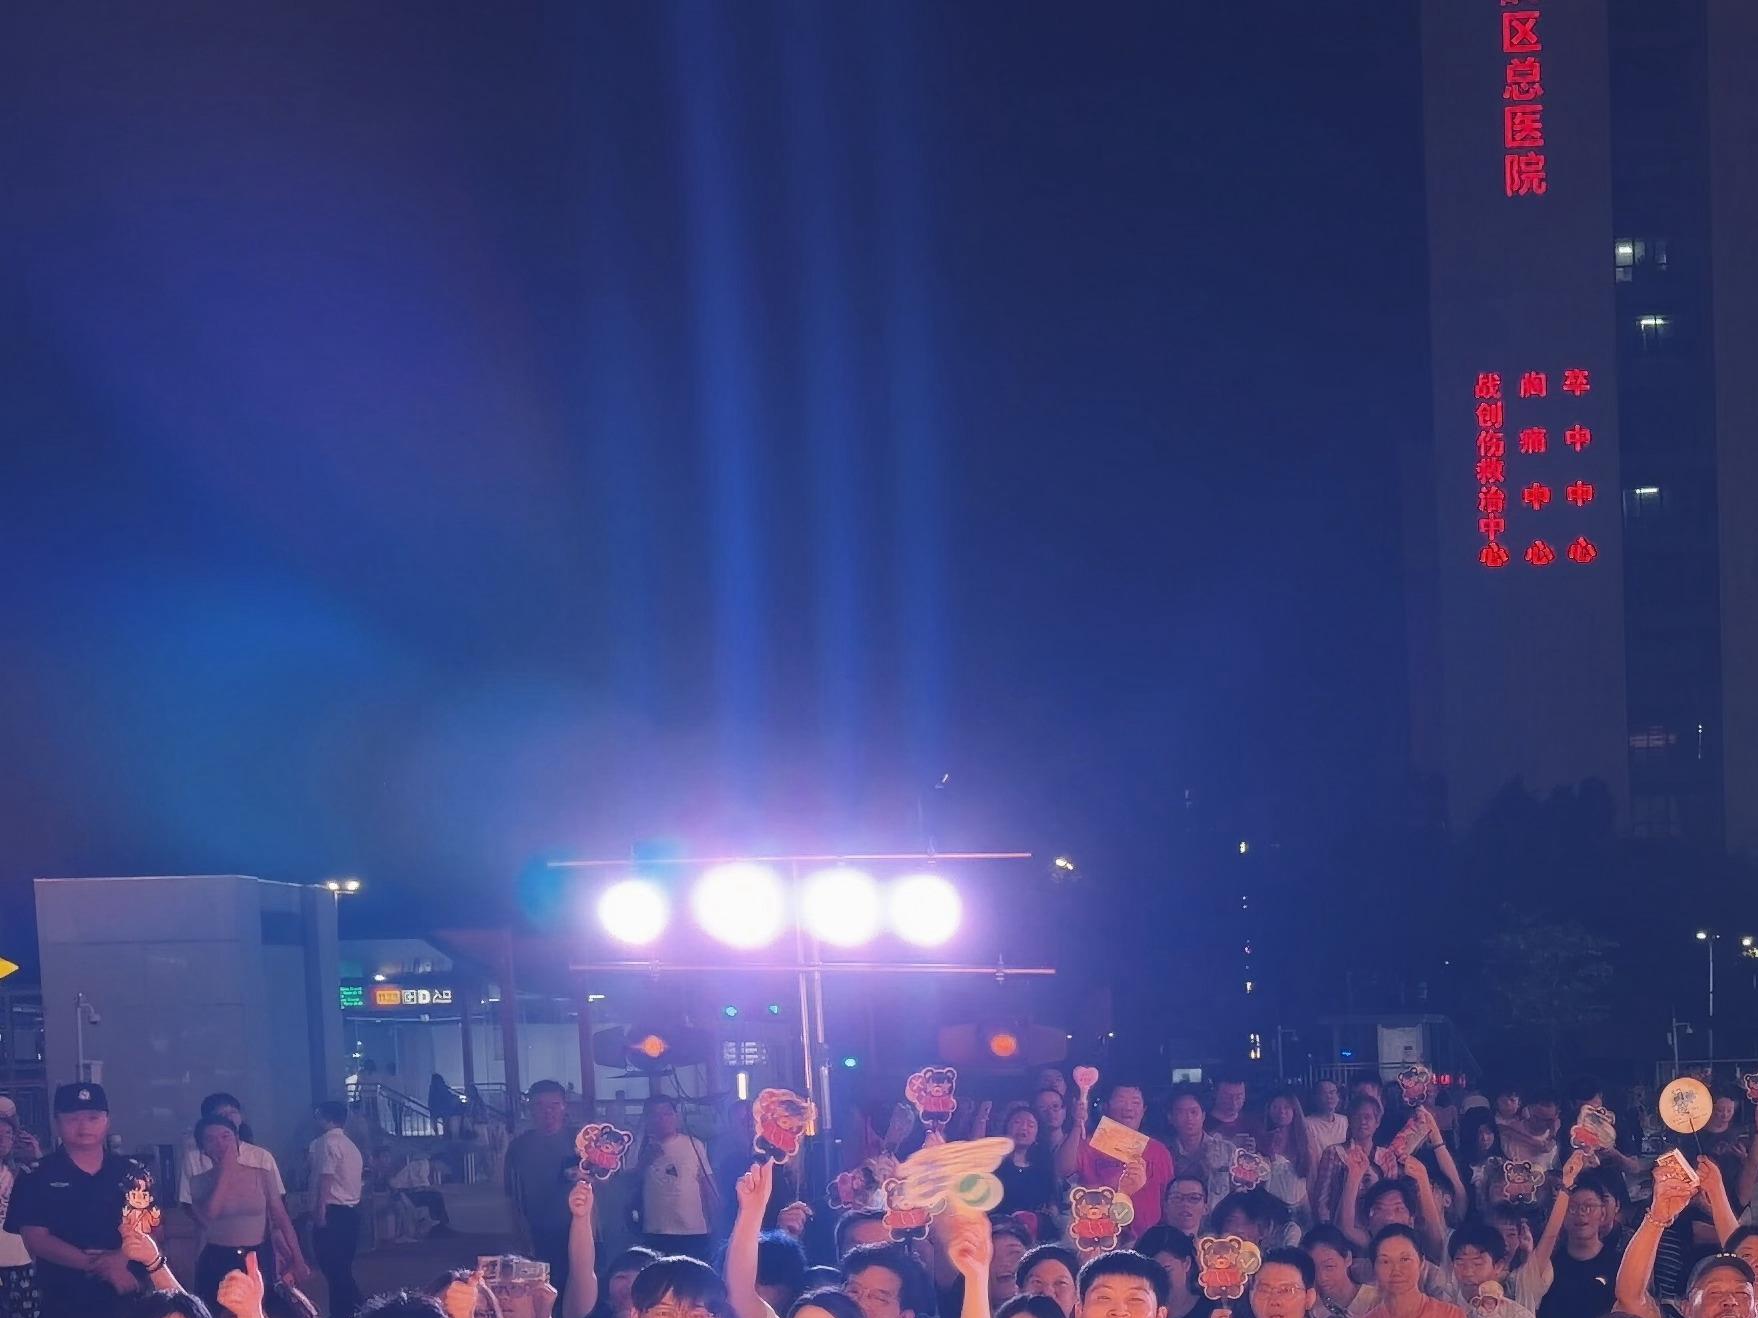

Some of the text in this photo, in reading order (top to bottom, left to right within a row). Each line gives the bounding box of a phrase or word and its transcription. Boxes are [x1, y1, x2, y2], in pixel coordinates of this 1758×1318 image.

[1500, 0, 1547, 198] 区总医院
[1474, 372, 1509, 567] 战创伤救治中心
[1520, 371, 1555, 566] 胸痛中心
[1563, 369, 1597, 564] 卒中中心
